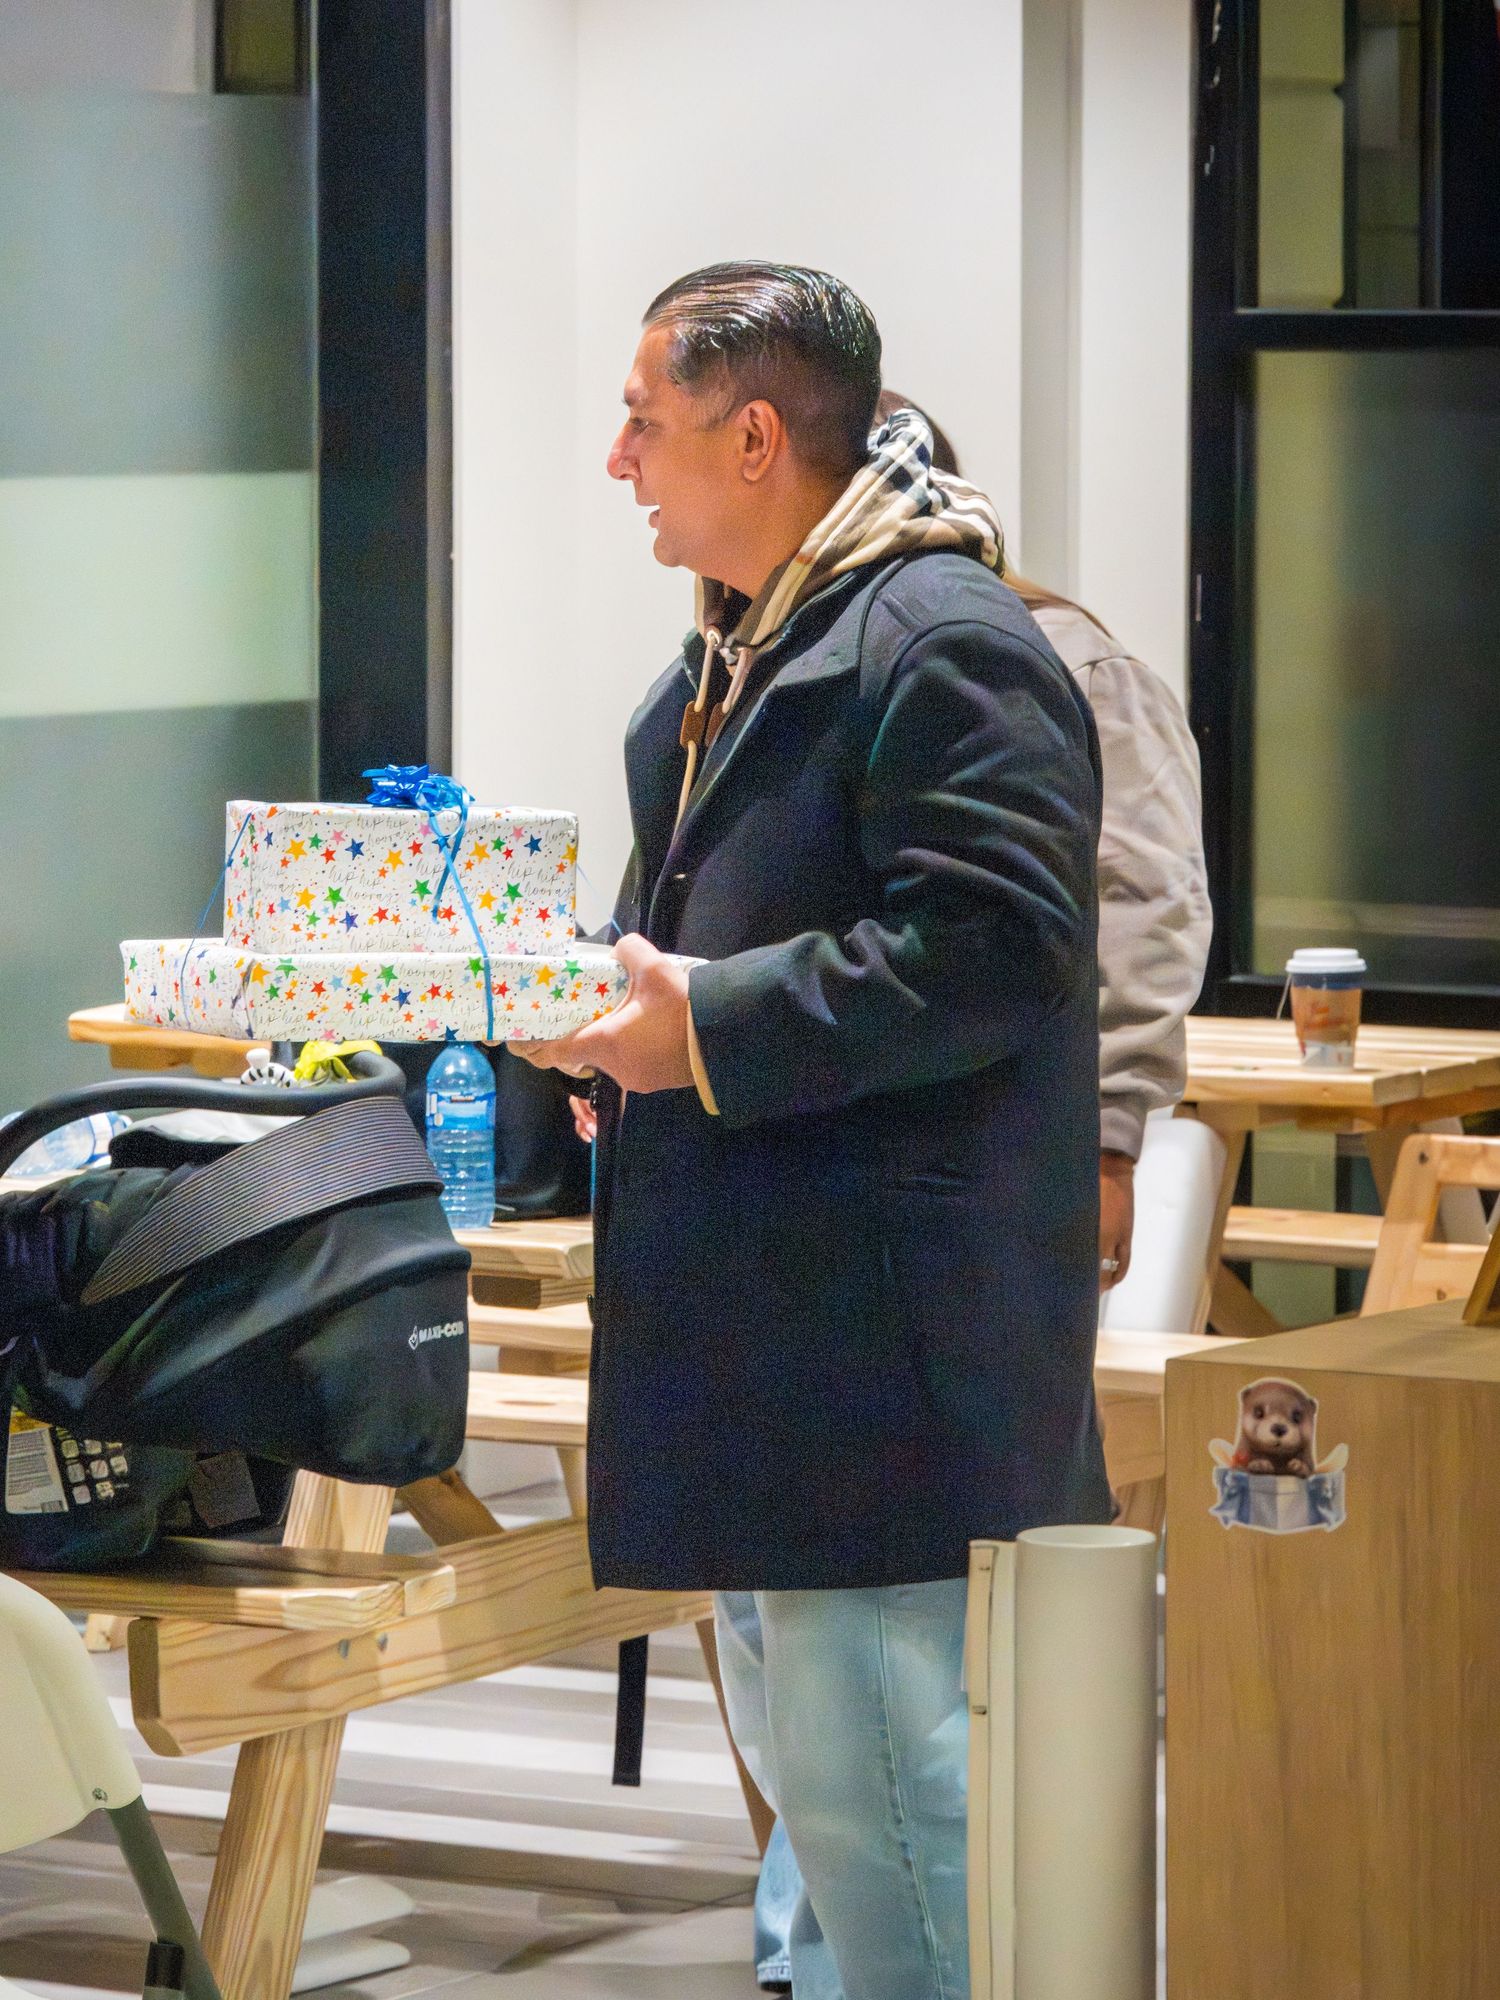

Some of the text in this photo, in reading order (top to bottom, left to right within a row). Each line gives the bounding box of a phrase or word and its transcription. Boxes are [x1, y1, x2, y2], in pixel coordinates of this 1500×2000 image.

[507, 861, 561, 885] hip hip
[524, 881, 575, 898] hooray
